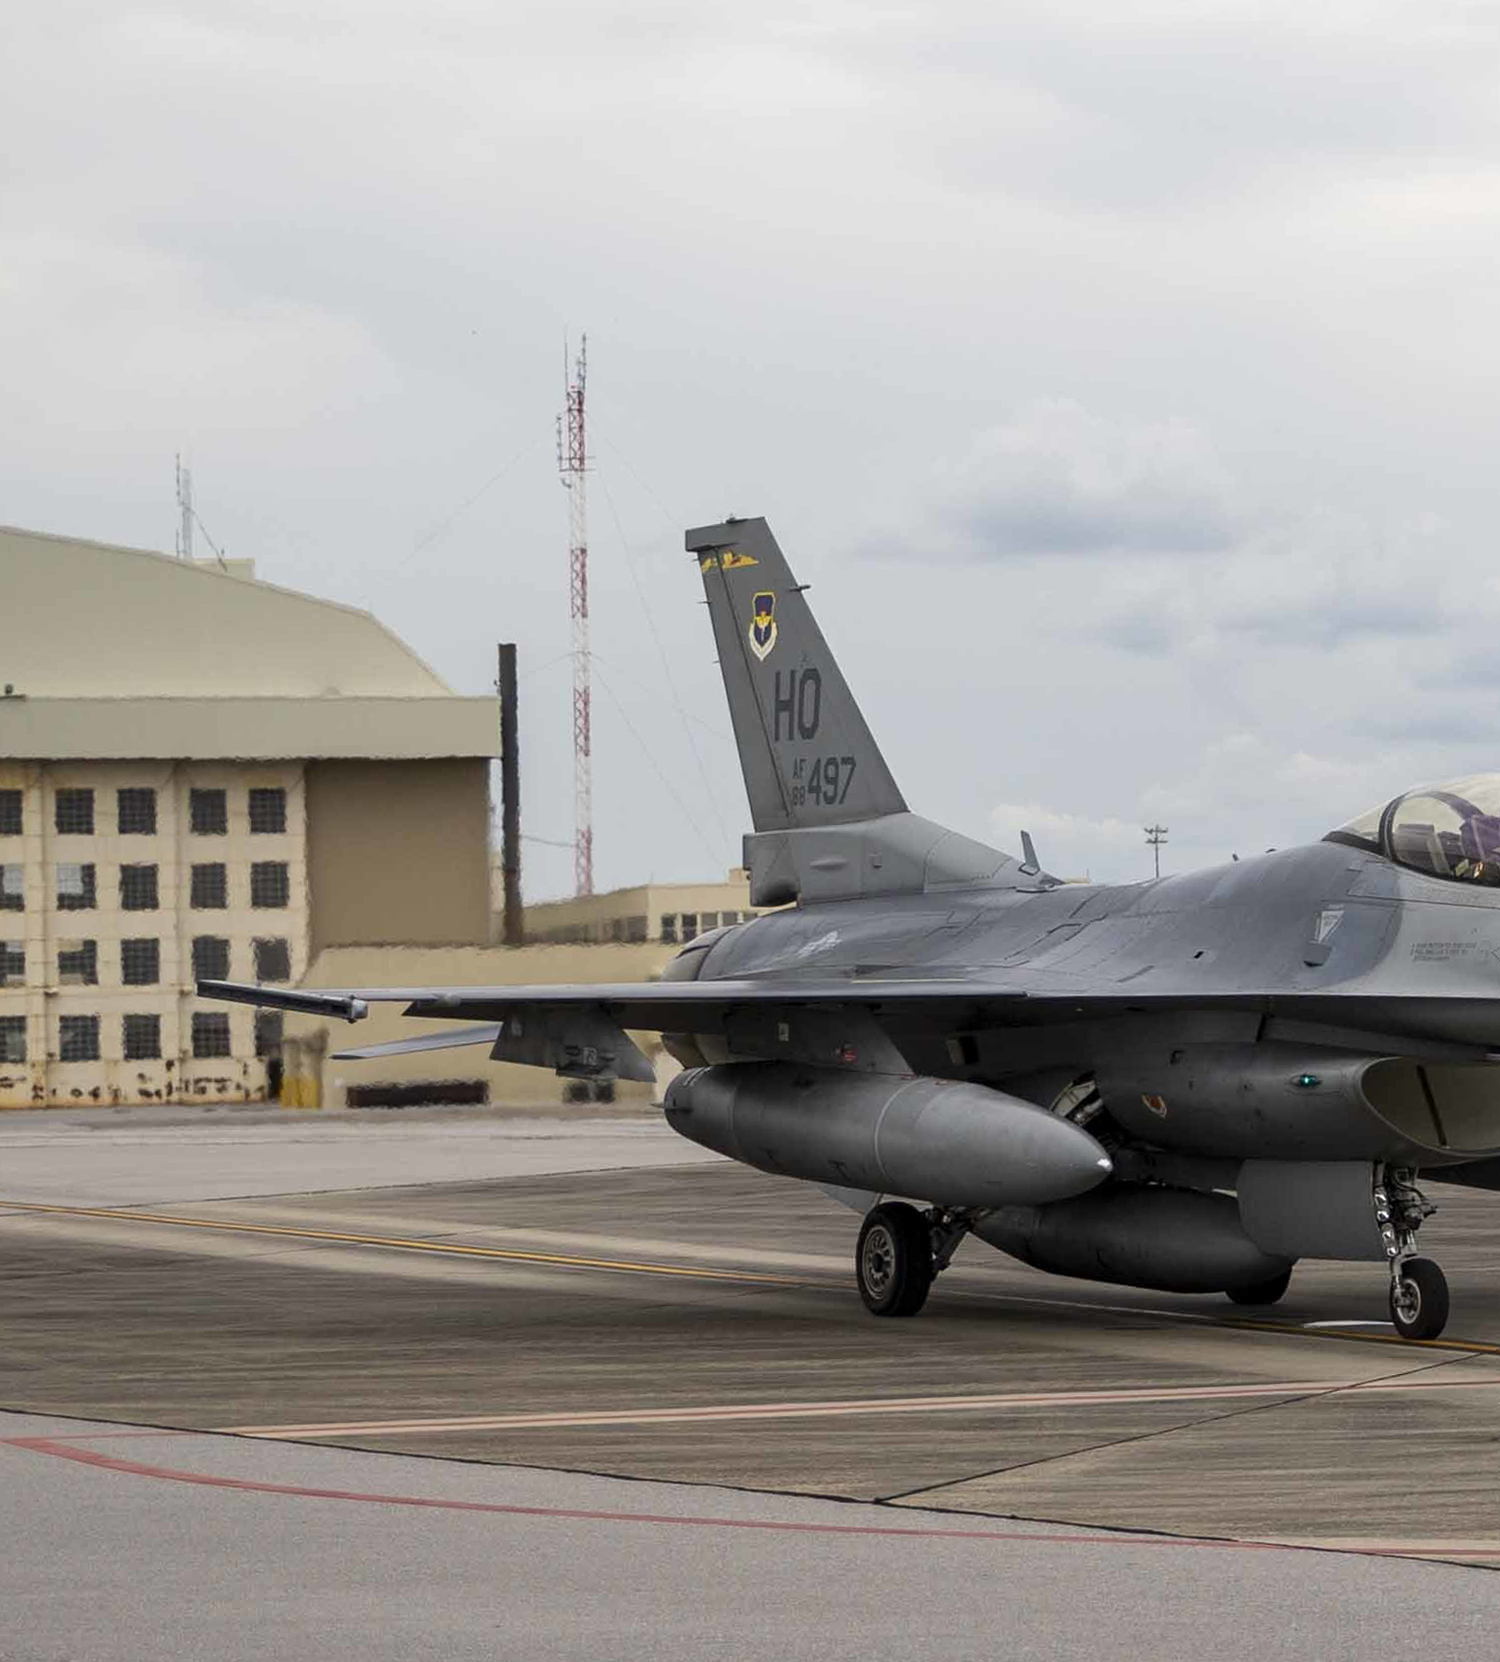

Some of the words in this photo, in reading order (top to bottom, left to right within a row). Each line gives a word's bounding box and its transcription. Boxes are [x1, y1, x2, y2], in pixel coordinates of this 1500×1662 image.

[774, 668, 822, 742] HO
[793, 757, 807, 779] AF
[807, 756, 857, 806] 497
